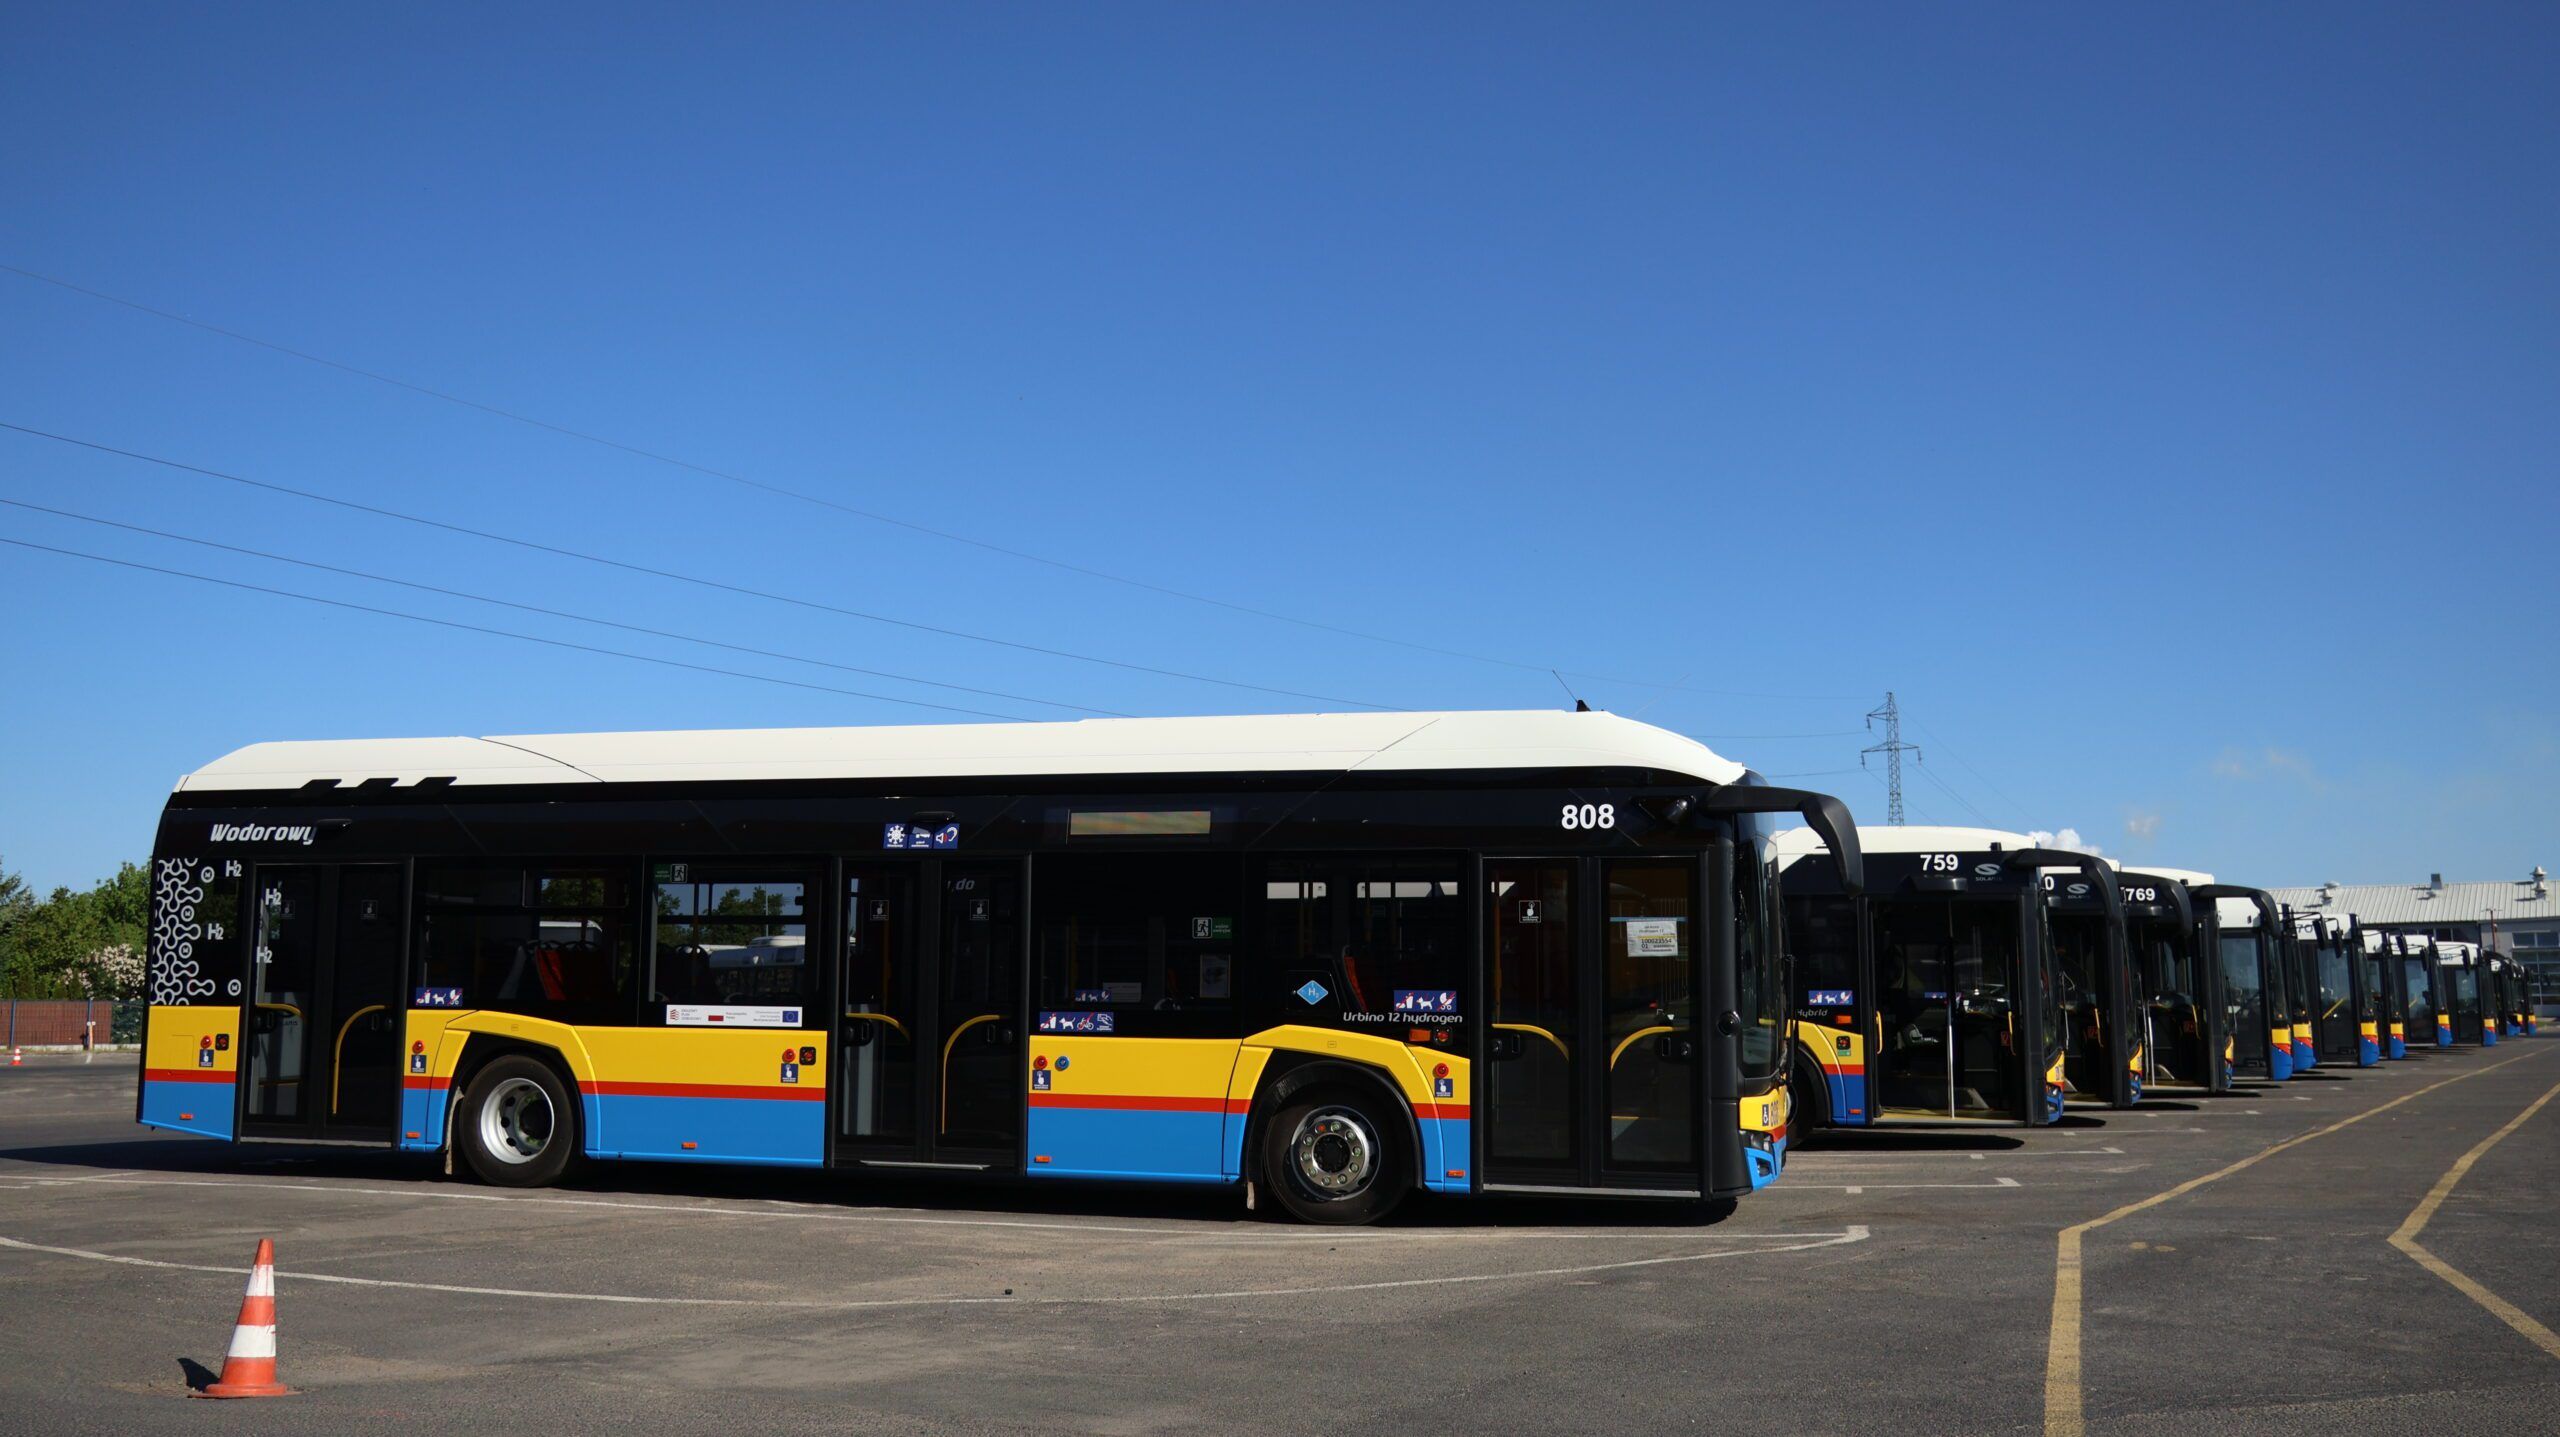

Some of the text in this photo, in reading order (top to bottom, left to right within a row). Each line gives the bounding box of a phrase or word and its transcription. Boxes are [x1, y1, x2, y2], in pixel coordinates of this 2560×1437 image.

[1561, 803, 1615, 830] 808
[210, 823, 317, 845] Wodorowy
[225, 860, 243, 878] H2
[1919, 853, 1959, 871] 759
[265, 888, 282, 906] H2
[2125, 887, 2156, 901] 769
[207, 923, 224, 941] H2
[256, 946, 273, 964] H2
[1343, 1011, 1463, 1025] Urbino 12 hydrogen
